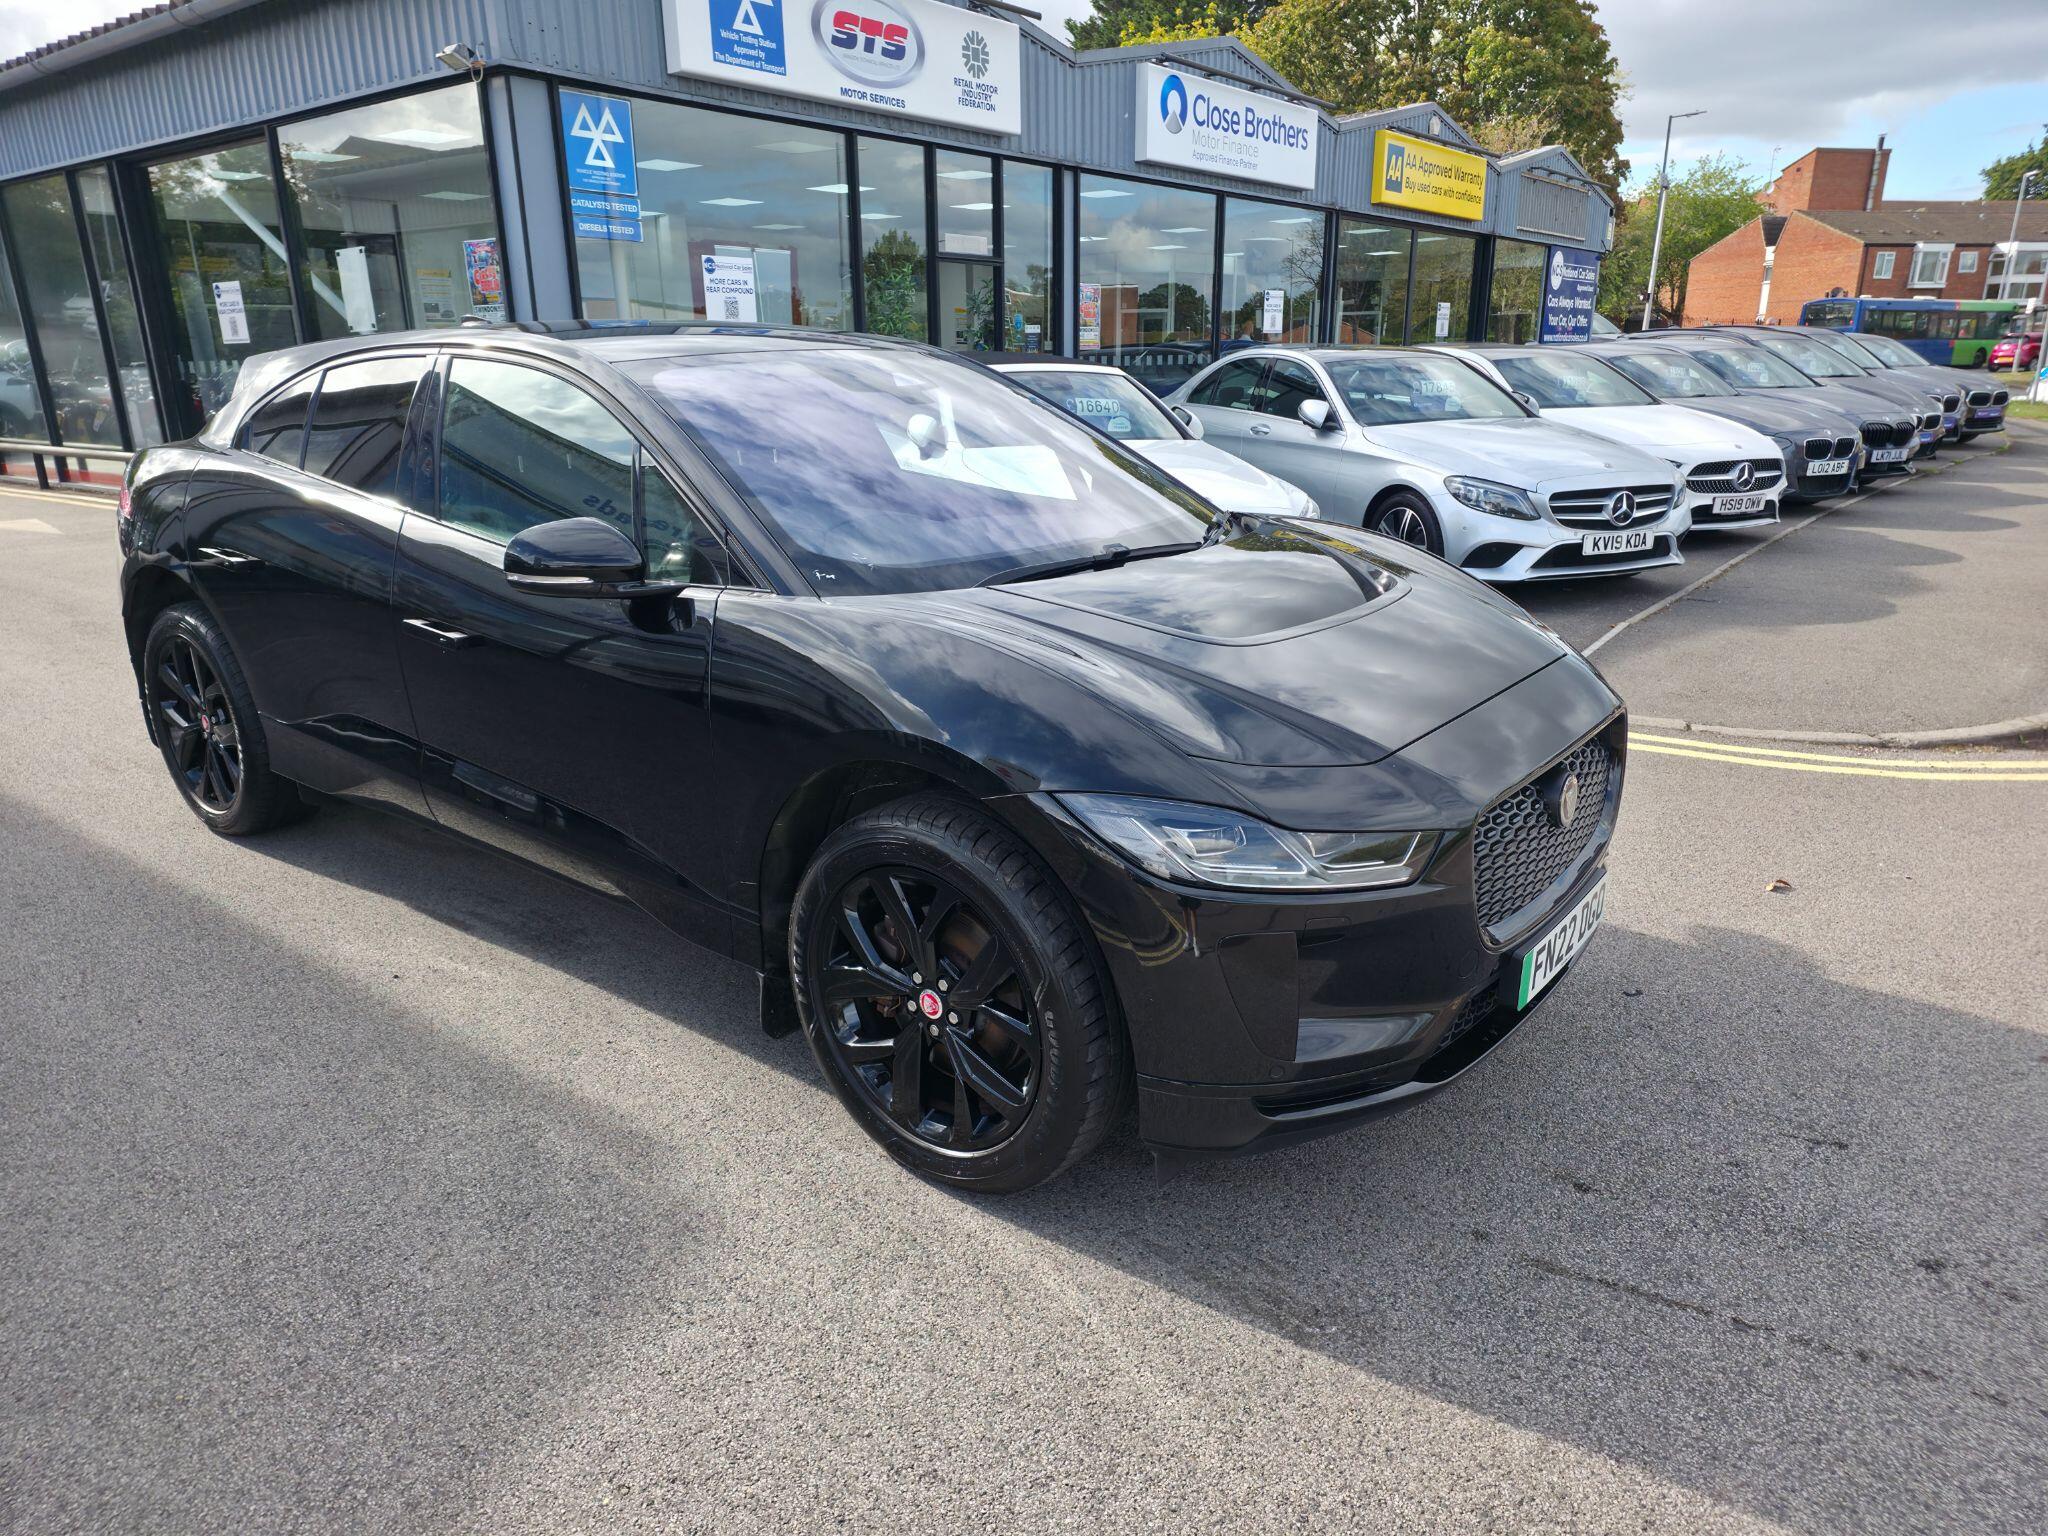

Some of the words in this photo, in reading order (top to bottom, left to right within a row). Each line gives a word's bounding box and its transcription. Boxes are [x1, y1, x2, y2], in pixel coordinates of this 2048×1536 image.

[720, 29, 739, 40] Vehicle
[740, 34, 758, 46] Testing
[759, 38, 776, 49] Station
[831, 10, 908, 60] STS
[734, 44, 758, 57] Approved
[759, 49, 765, 59] by
[715, 52, 724, 61] The
[726, 54, 754, 67] Department
[762, 62, 785, 74] Transport
[954, 77, 973, 89] RETAIL
[976, 82, 998, 95] MOTOR
[962, 88, 992, 102] INDUSTRY
[840, 87, 867, 101] MOTOR
[870, 93, 905, 108] SERVICES
[959, 97, 995, 112] FEDERATION
[1193, 94, 1240, 135] Close
[1245, 107, 1308, 150] Brothers
[1192, 130, 1220, 149] Motor
[1223, 136, 1258, 157] Finance
[1192, 150, 1218, 164] Approved
[1218, 154, 1239, 167] Finance
[1240, 159, 1258, 170] Partner
[1388, 155, 1402, 181] AA
[1406, 153, 1416, 169] AA
[1418, 156, 1452, 178] Approved
[1454, 166, 1483, 189] Warranty
[1405, 177, 1416, 193] Buy
[1417, 181, 1430, 193] used
[1432, 185, 1442, 196] cars
[1443, 188, 1454, 199] with
[1456, 190, 1481, 204] confidence
[571, 199, 610, 209] CATALYSTS
[611, 203, 637, 212] TESTED
[579, 223, 608, 232] DIESELS
[609, 226, 634, 234] TESTED
[1563, 266, 1579, 278] National
[1548, 294, 1558, 307] Cars
[1559, 296, 1574, 311] Always
[1549, 314, 1558, 325] Your
[1568, 315, 1576, 327] Our
[1720, 499, 1743, 511] HS19
[1592, 535, 1622, 551] KV19
[1626, 533, 1646, 549] KDA
[1532, 914, 1577, 990] FN22
